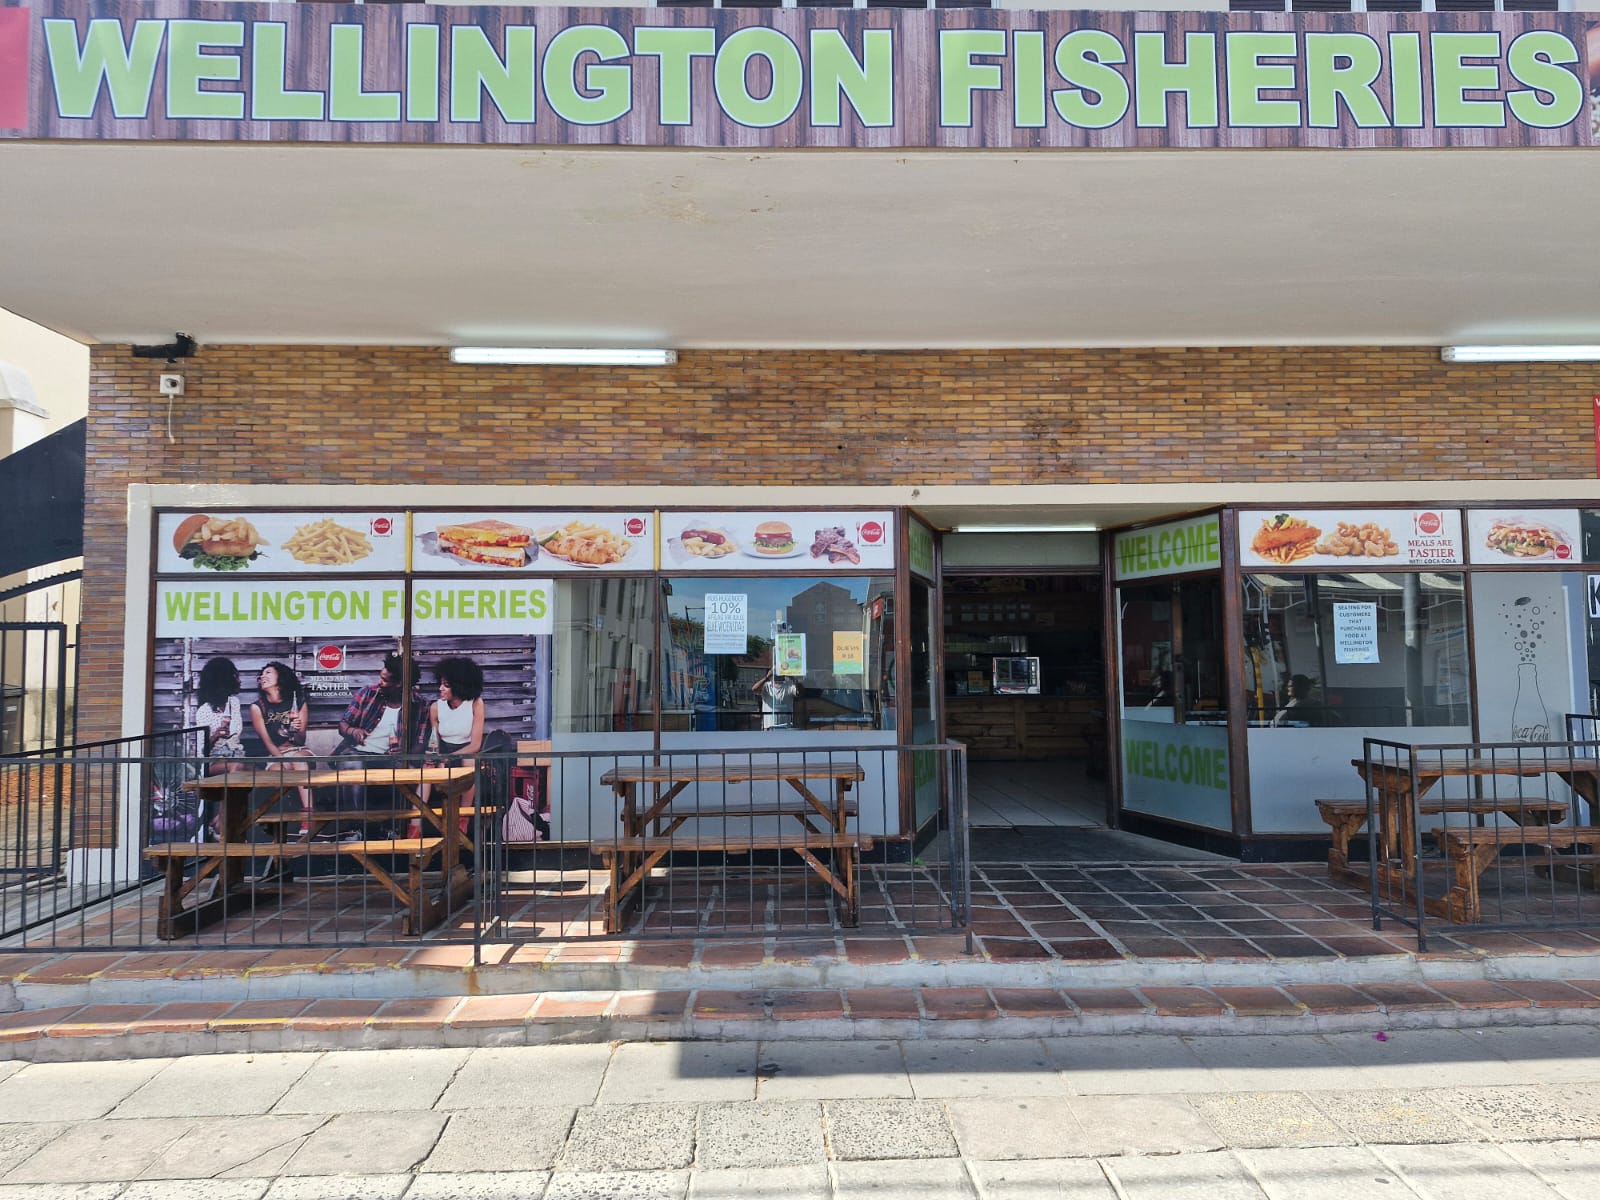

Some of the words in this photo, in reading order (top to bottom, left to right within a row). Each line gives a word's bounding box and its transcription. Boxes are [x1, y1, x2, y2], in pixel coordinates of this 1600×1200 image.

[42, 18, 895, 128] WELLINGTON
[938, 29, 1584, 128] FISHERIES
[1119, 521, 1219, 574] WELCOME
[1408, 539, 1435, 547] MEALS
[1437, 539, 1454, 547] ARE
[1408, 548, 1455, 558] TASTIER
[164, 590, 370, 622] WELLINGTON
[381, 589, 547, 621] FISHERIES
[711, 601, 741, 614] 10%
[310, 682, 350, 691] TASTIER
[1124, 738, 1227, 790] WELCOME
